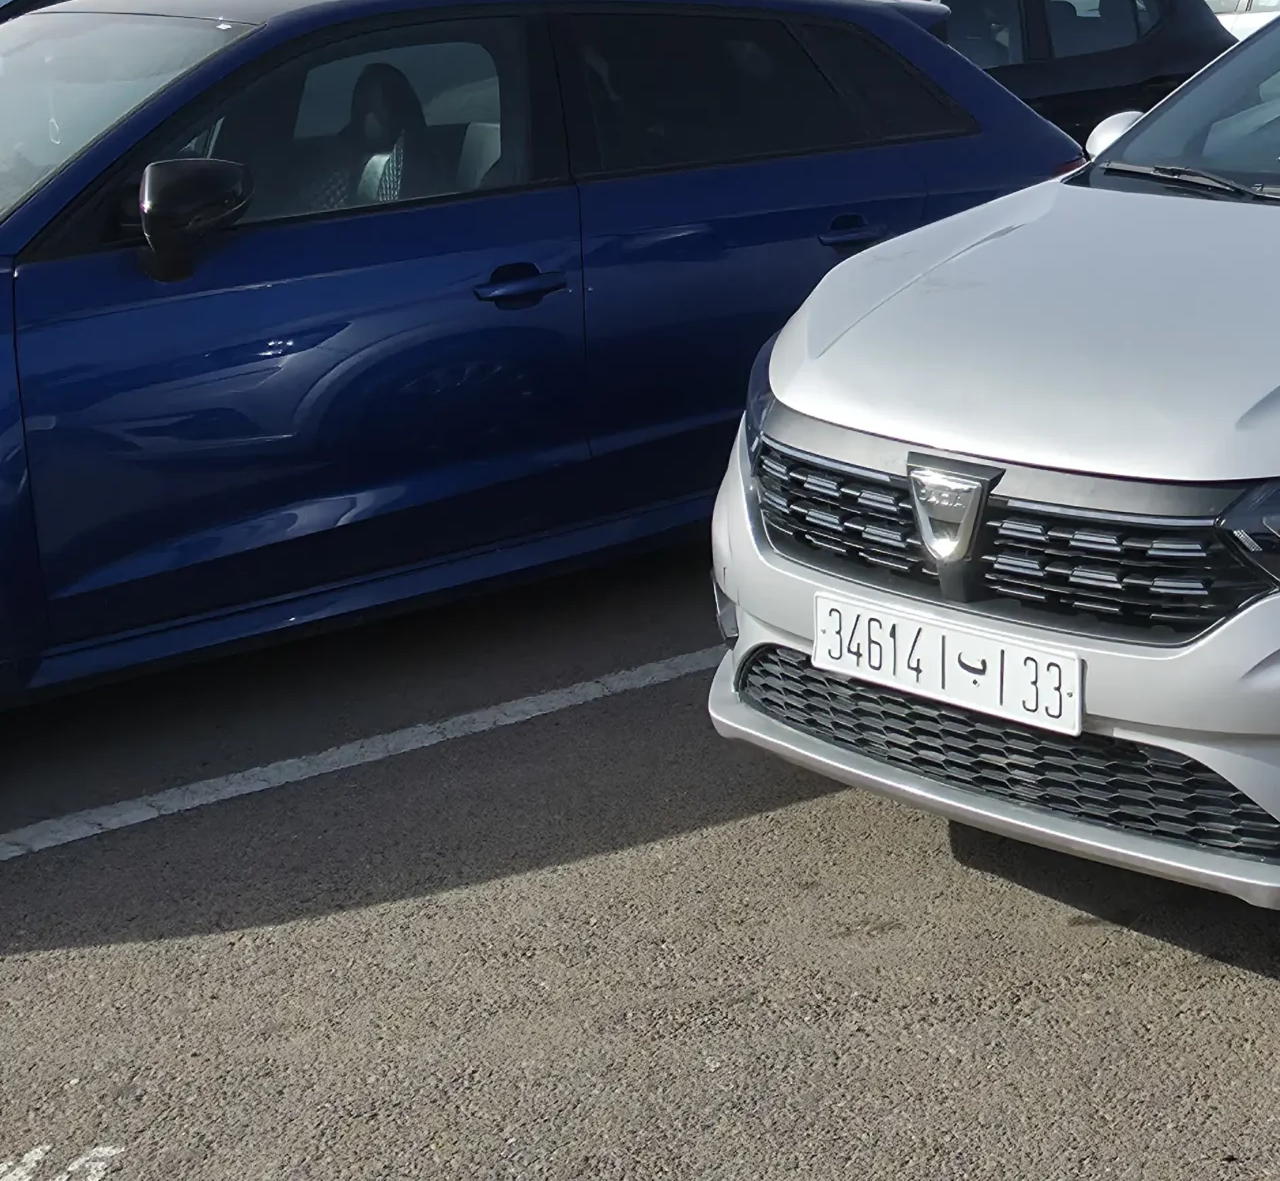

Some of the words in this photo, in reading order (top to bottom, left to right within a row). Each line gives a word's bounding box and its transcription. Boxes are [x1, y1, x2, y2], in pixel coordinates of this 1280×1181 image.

[827, 607, 923, 683] 34614
[957, 650, 988, 687] ب
[1022, 656, 1062, 719] 33
